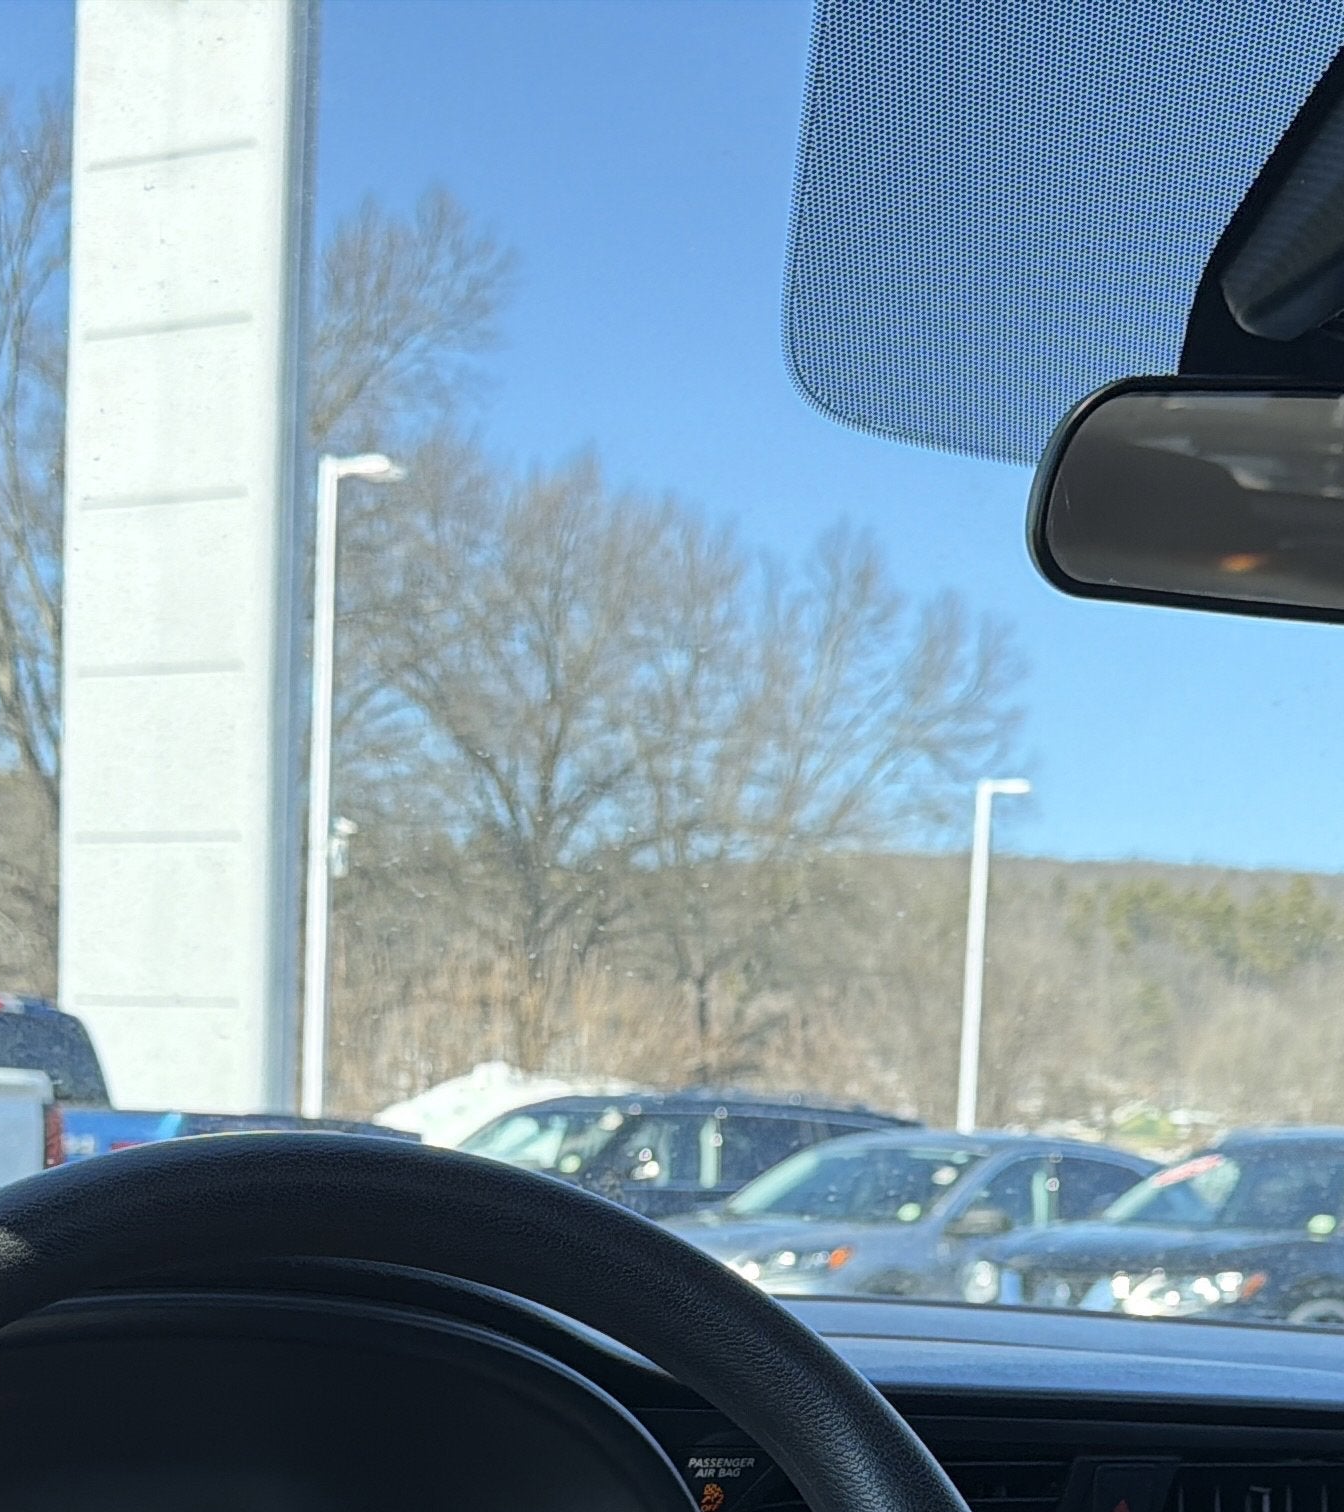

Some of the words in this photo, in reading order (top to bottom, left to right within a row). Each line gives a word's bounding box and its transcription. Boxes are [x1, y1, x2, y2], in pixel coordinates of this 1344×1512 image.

[688, 1457, 755, 1469] PASSENGER
[694, 1467, 715, 1478] AIR
[717, 1467, 742, 1478] BAG
